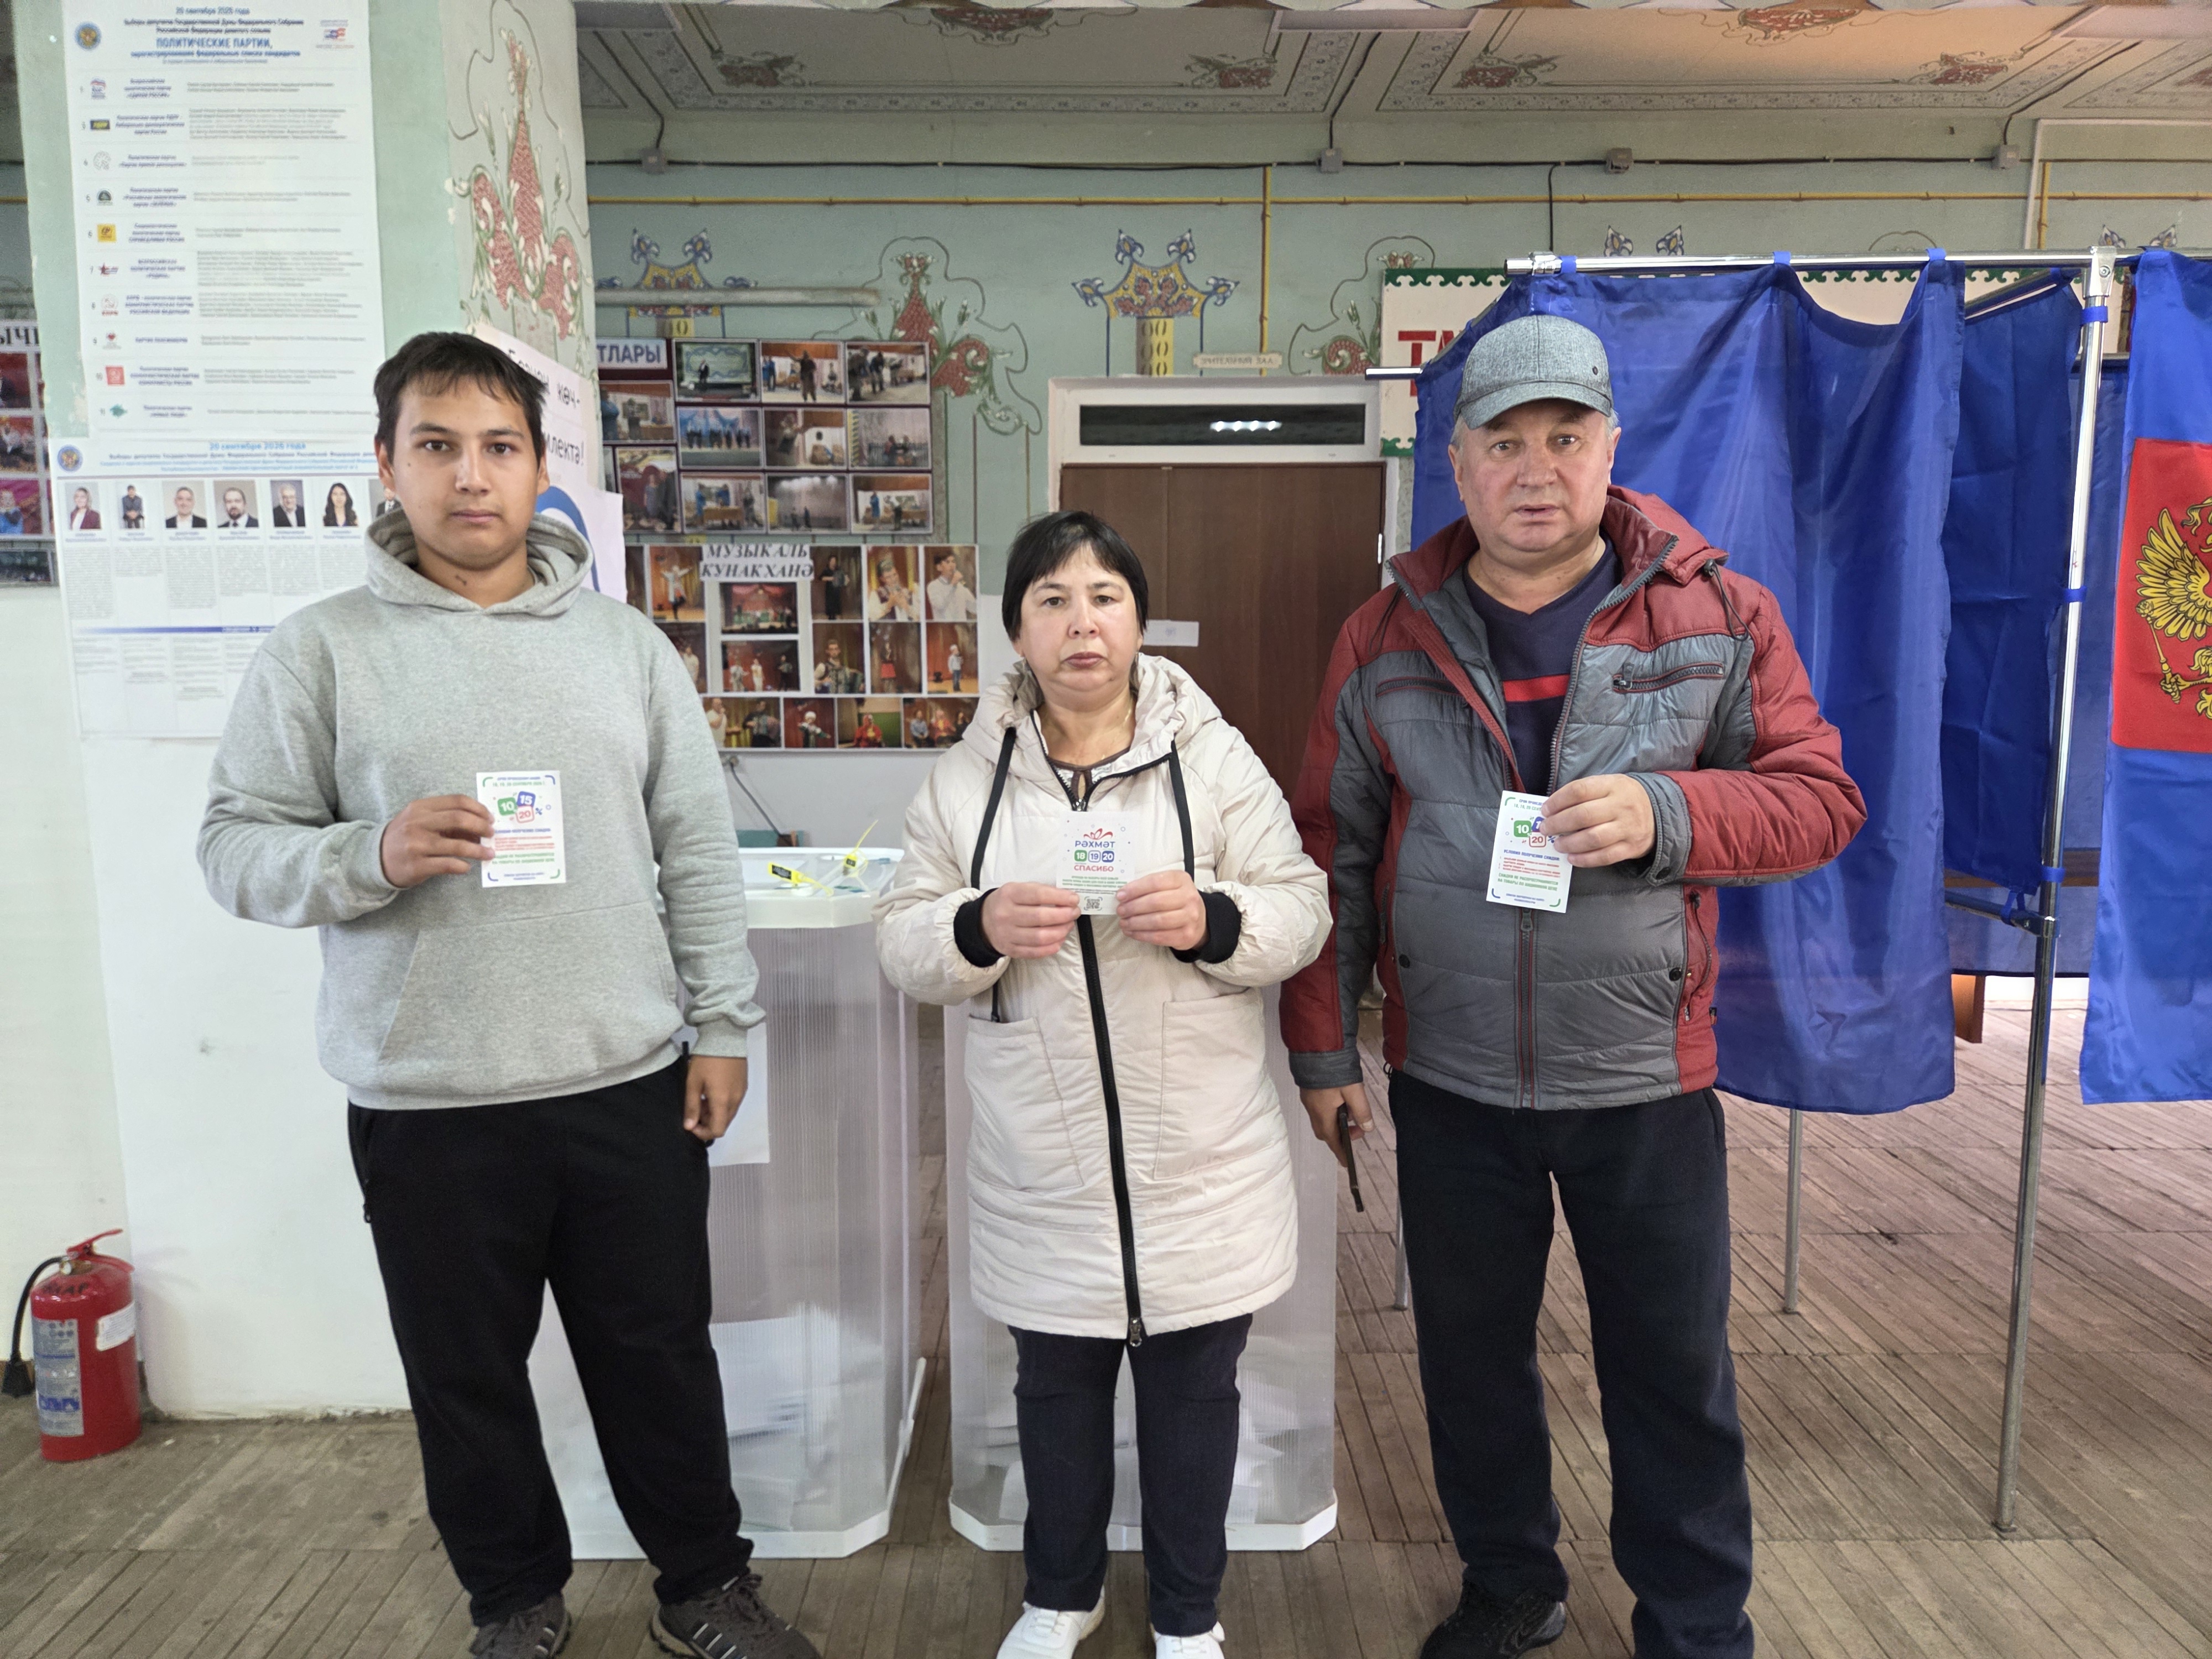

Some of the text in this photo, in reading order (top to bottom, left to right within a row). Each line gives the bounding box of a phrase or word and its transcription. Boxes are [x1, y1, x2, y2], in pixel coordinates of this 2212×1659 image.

[156, 37, 230, 49] ПОЛИТИЧЕСКИЕ
[707, 543, 807, 559] МУЗЫКАЛЬ
[520, 795, 533, 805] 15
[501, 801, 514, 812] 10
[518, 810, 531, 819] 20
[1516, 824, 1530, 834] 10
[1074, 840, 1116, 848] РӘХМӘТ
